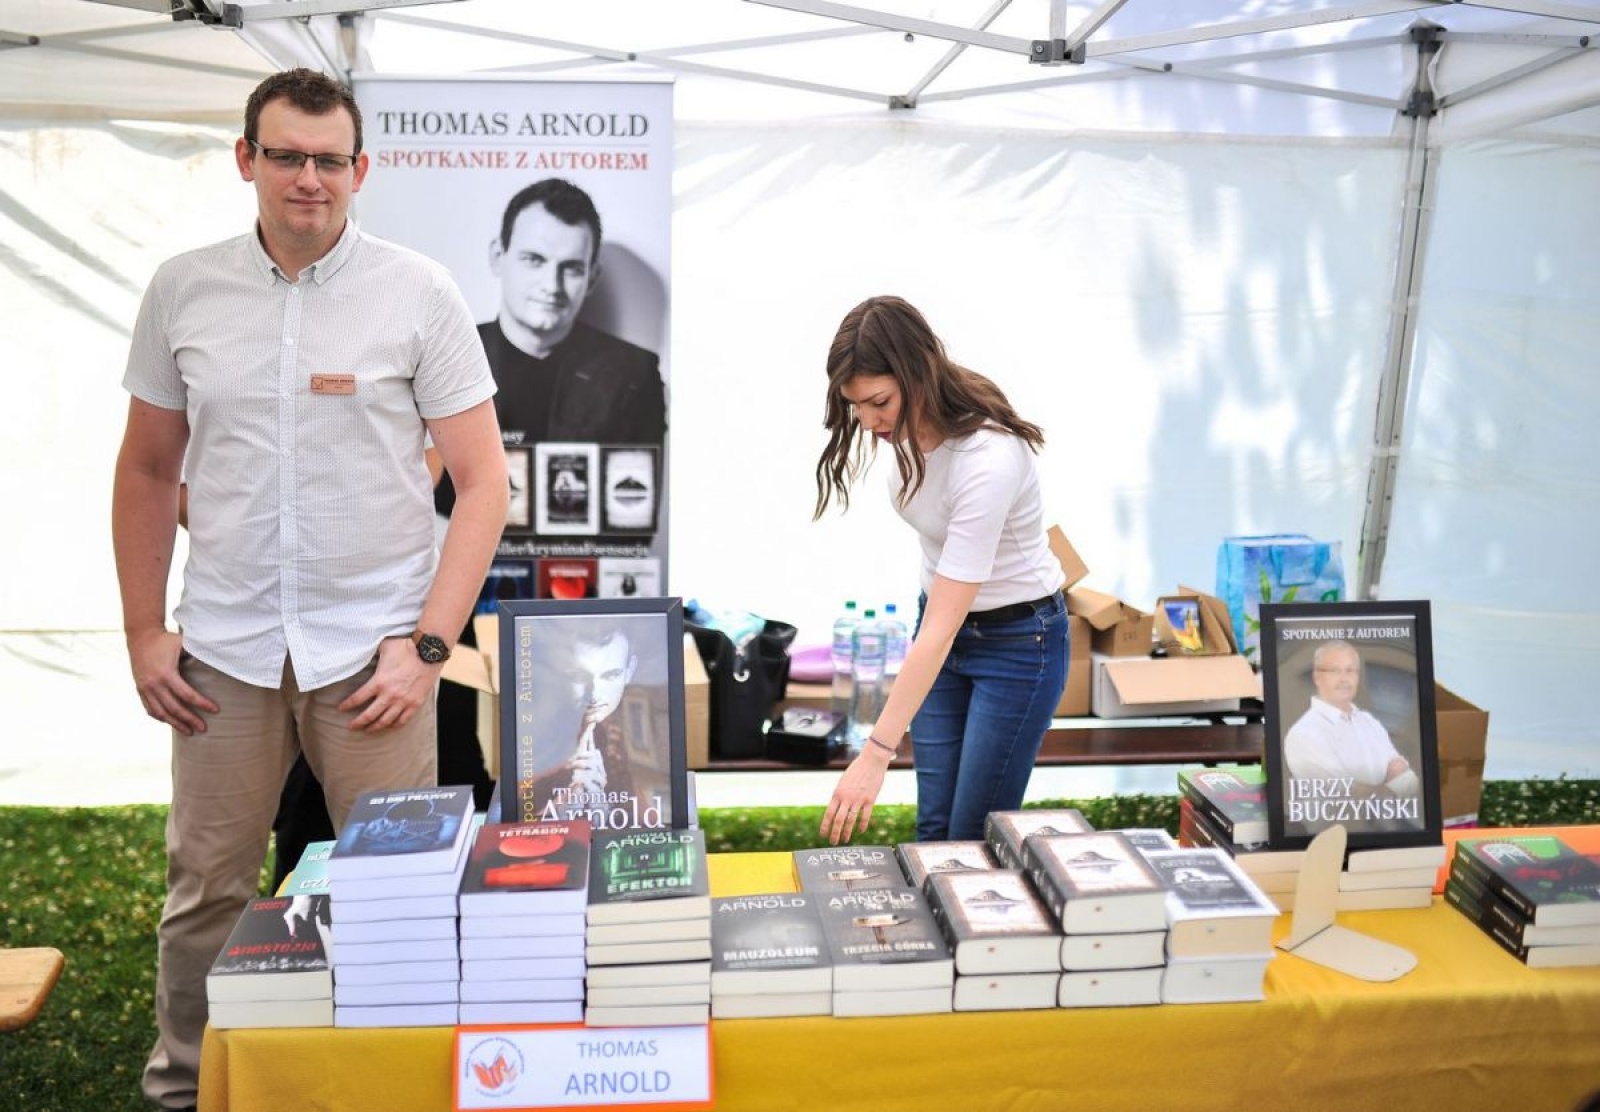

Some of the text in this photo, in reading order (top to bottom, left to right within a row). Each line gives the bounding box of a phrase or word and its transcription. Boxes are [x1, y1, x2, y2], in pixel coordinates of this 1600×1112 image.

[377, 112, 650, 138] THOMAS ARNOLD
[377, 149, 649, 170] SPOTKANIE Z AUTOREM
[1282, 627, 1411, 641] SPOTKANIE Z AUTOREM
[519, 624, 533, 703] Autorem
[520, 735, 538, 823] potkanie
[1288, 777, 1355, 801] JERZY
[552, 787, 629, 805] Thomas
[540, 796, 665, 830] Arnold
[1288, 794, 1419, 823] BUCZYŃSKI
[499, 827, 569, 838] TETRAGON
[605, 835, 694, 850] ARNOLD
[807, 851, 885, 865] ARNOLD
[718, 898, 806, 913] ARNOLD
[828, 893, 916, 909] ARNOLD
[722, 946, 819, 961] MAUZOLEUM
[577, 1039, 659, 1059] THOMAS
[564, 1070, 671, 1096] ARNOLD
